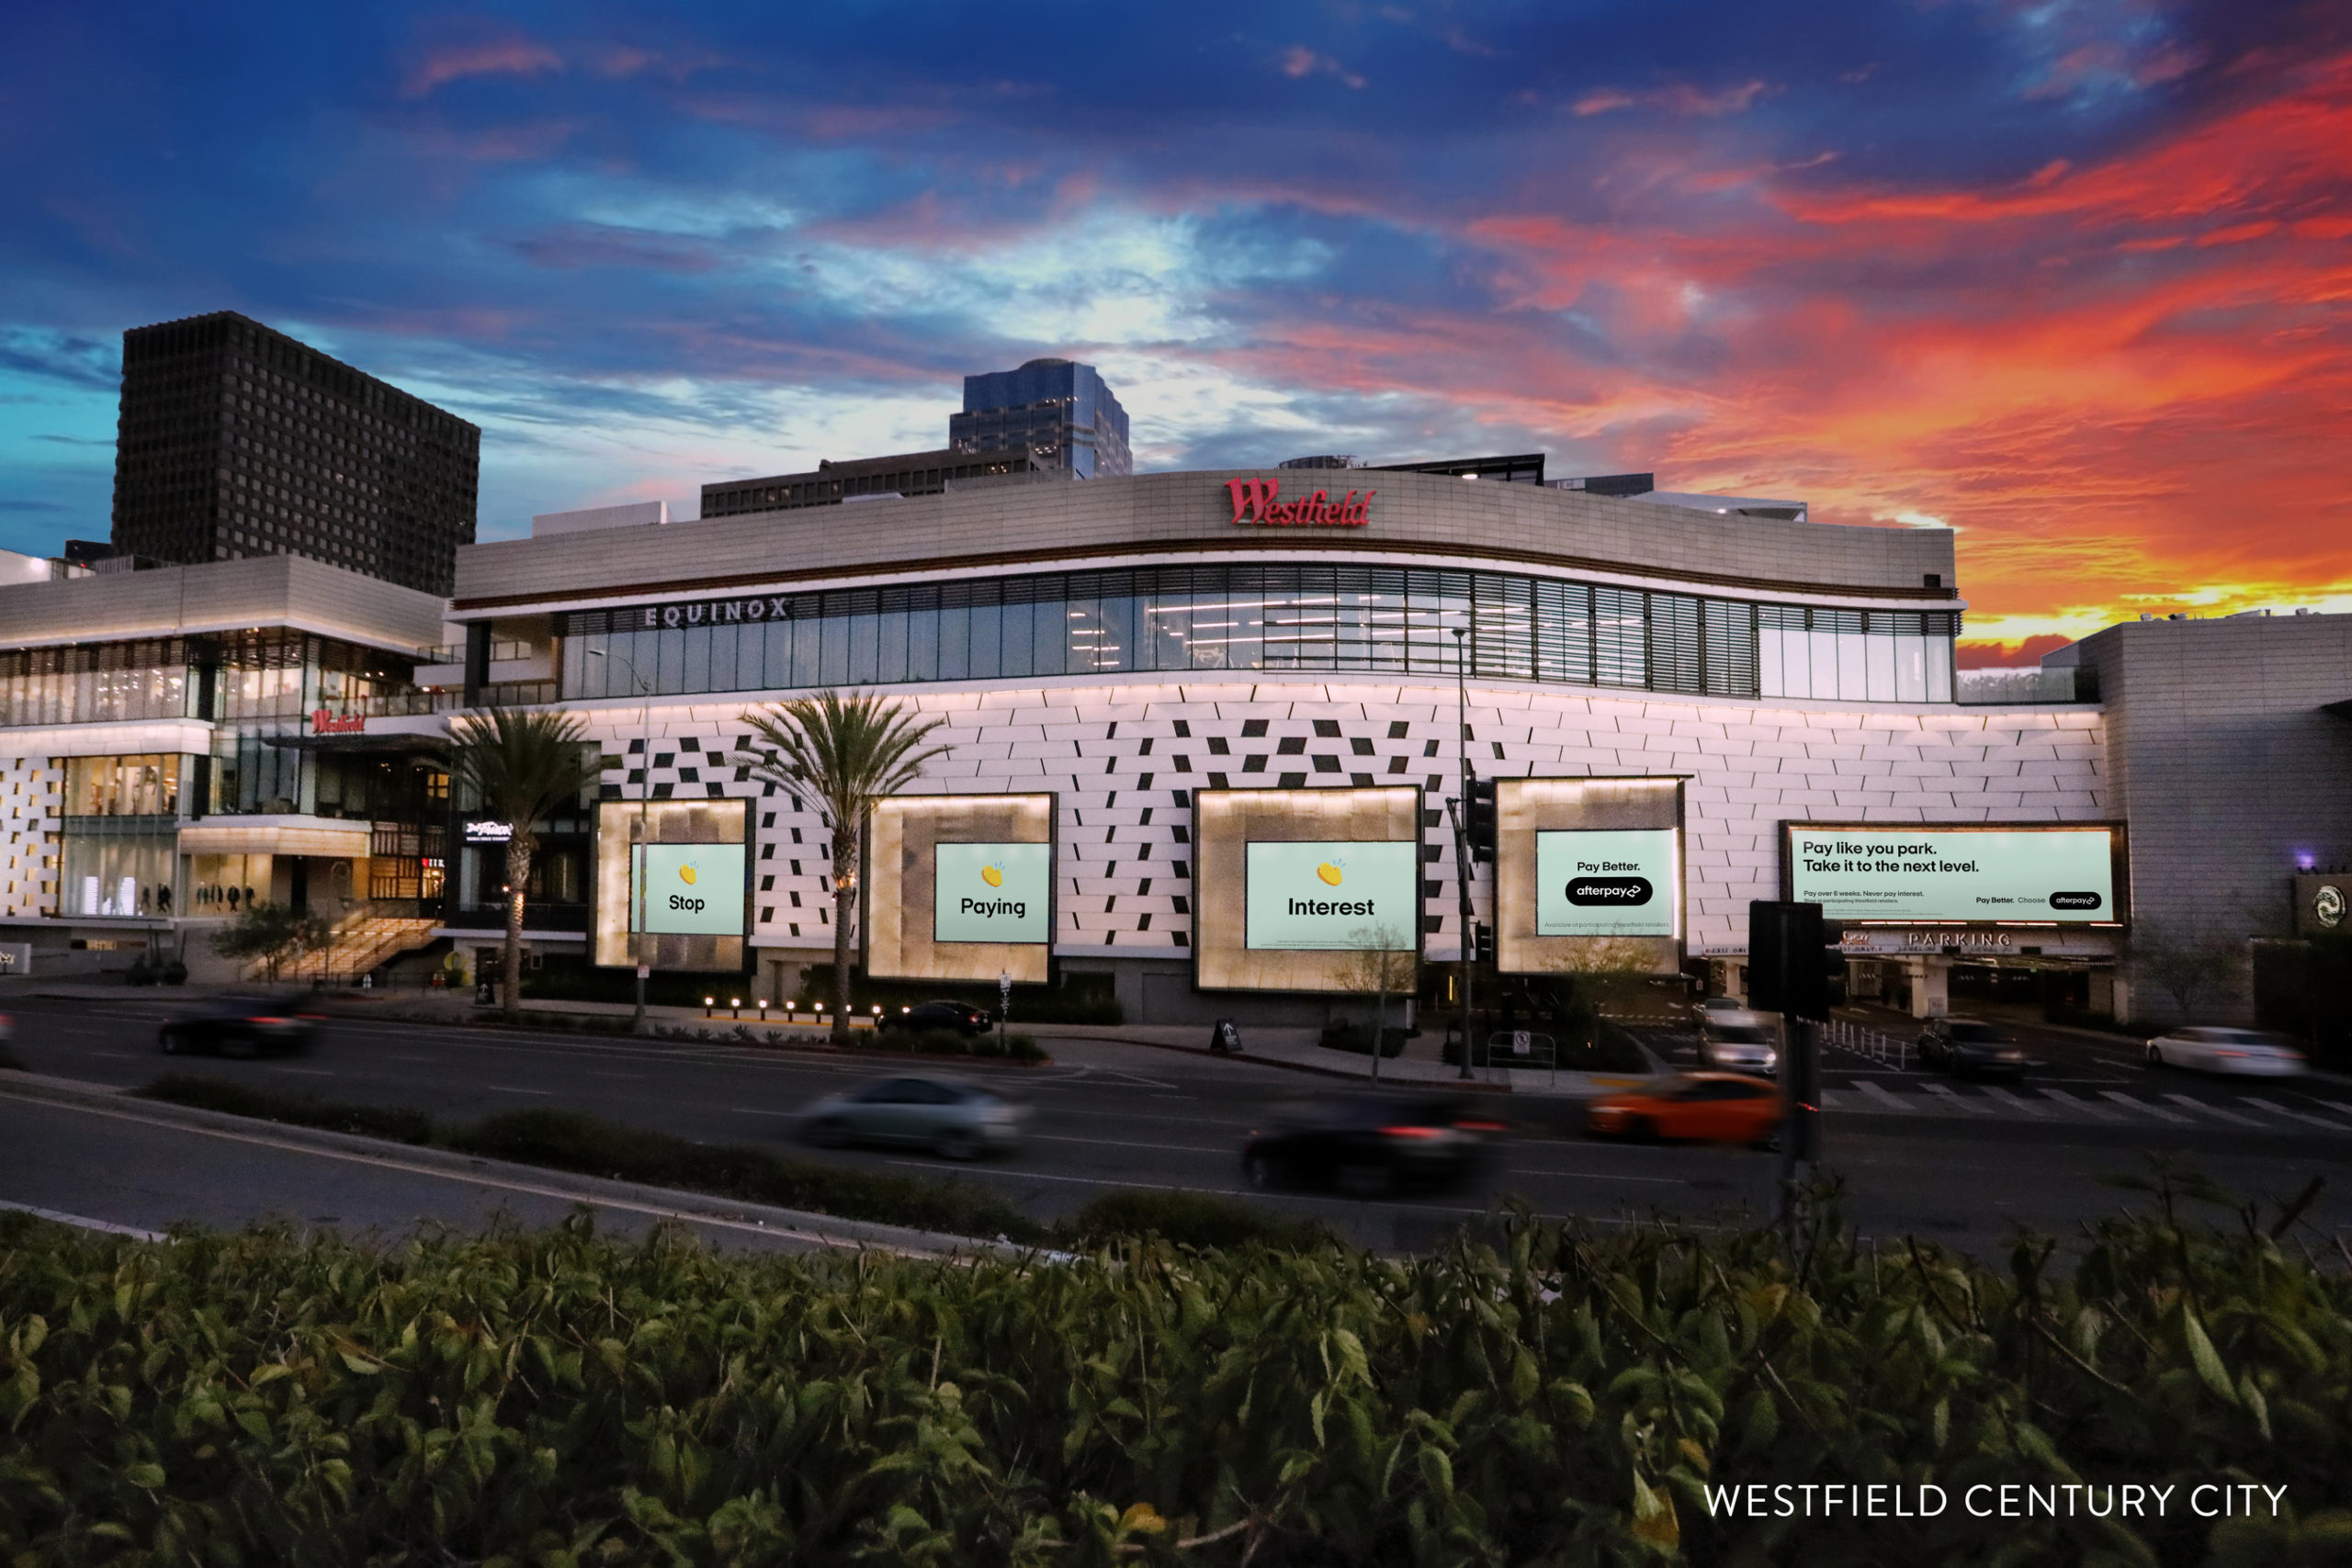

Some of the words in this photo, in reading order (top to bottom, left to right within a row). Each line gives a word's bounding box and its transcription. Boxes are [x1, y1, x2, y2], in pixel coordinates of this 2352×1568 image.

[1224, 477, 1377, 526] Westfield
[645, 598, 787, 627] EQUINOX
[1803, 841, 1834, 857] Pay
[1837, 841, 1863, 855] like
[1866, 844, 1894, 857] you
[1897, 842, 1938, 857] park.
[1577, 862, 1600, 874] Pay
[1602, 862, 1641, 872] Better.
[1803, 860, 1841, 873] Take
[1844, 860, 1854, 873] it
[1857, 861, 1872, 873] to
[1875, 860, 1900, 873] the
[1903, 861, 1937, 873] next
[1939, 860, 1980, 873] level.
[1577, 885, 1628, 898] afterpay
[669, 894, 706, 914] Stop
[961, 897, 1026, 919] Paying
[1288, 897, 1375, 916] Interest
[2055, 897, 2087, 905] afterpay
[1909, 933, 2011, 946] PARKING
